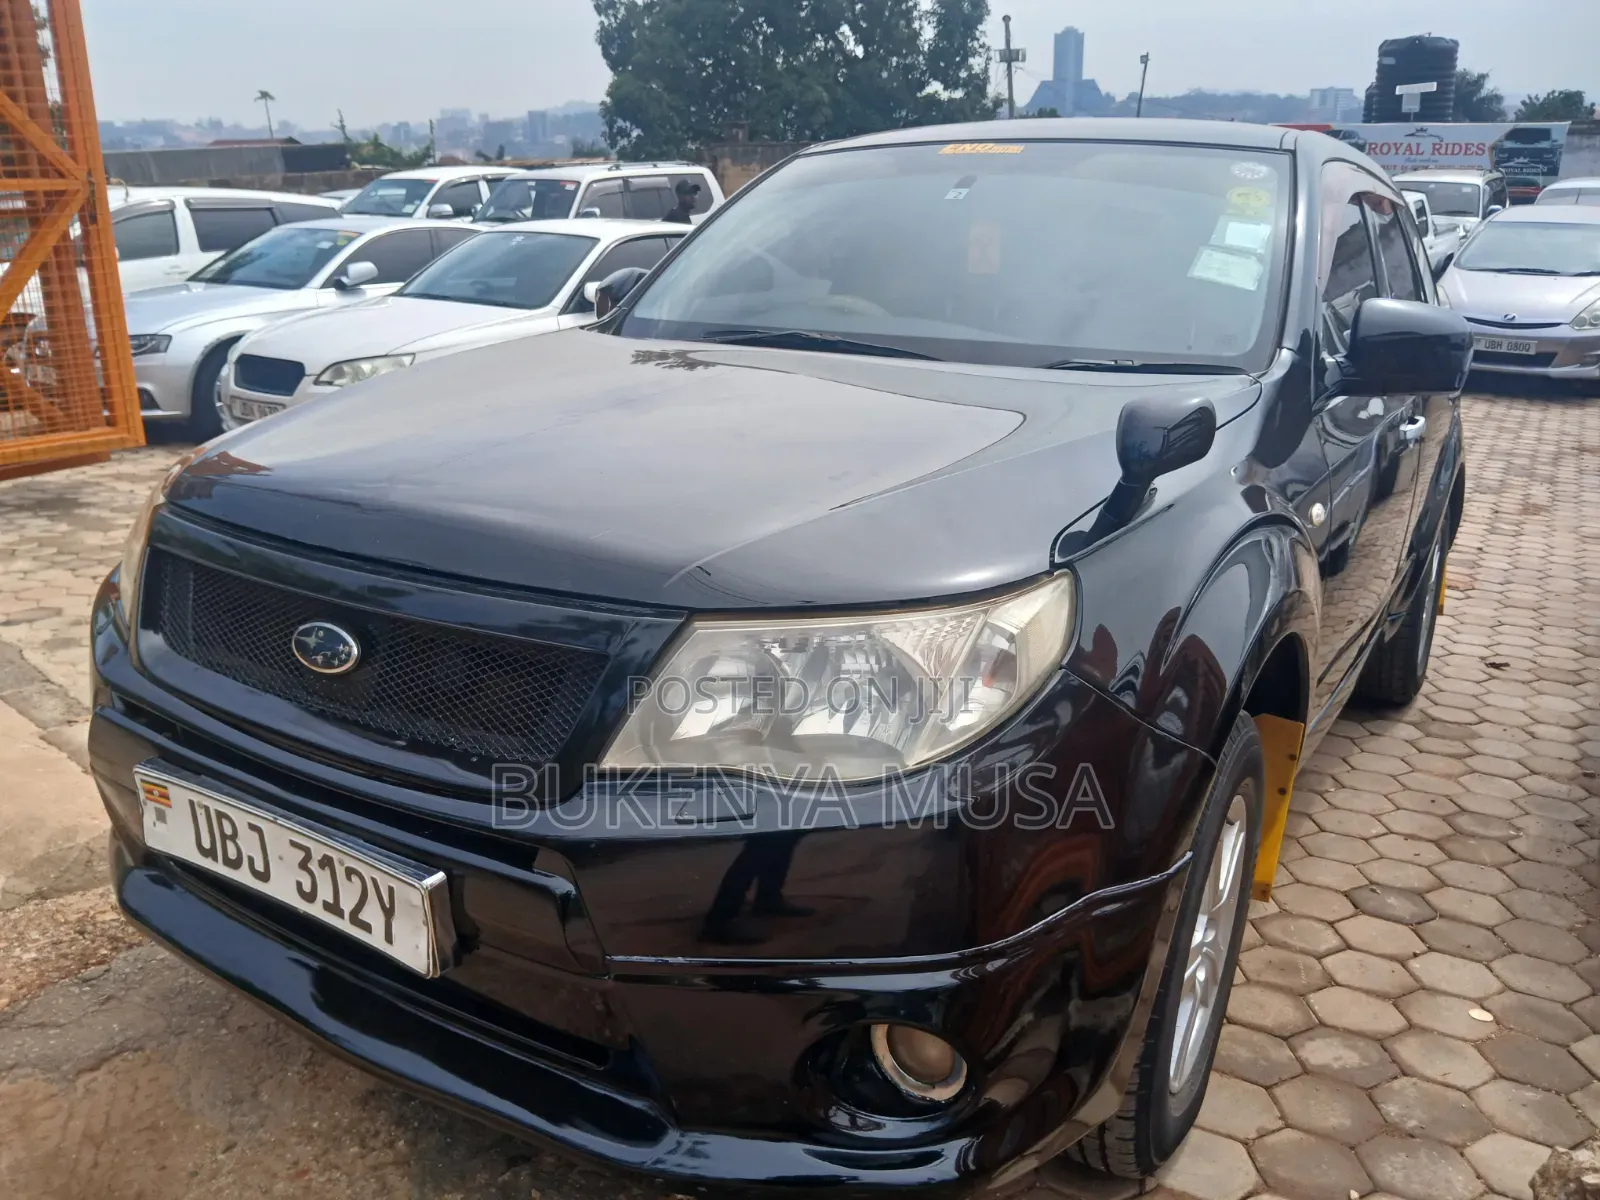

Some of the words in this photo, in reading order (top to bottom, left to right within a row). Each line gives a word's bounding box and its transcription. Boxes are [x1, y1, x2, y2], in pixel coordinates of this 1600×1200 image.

[1367, 142, 1424, 156] ROYAL
[1431, 142, 1486, 156] RIDES
[1484, 340, 1502, 350] UBH
[188, 798, 271, 883] UBJ
[289, 839, 396, 946] 312Y
